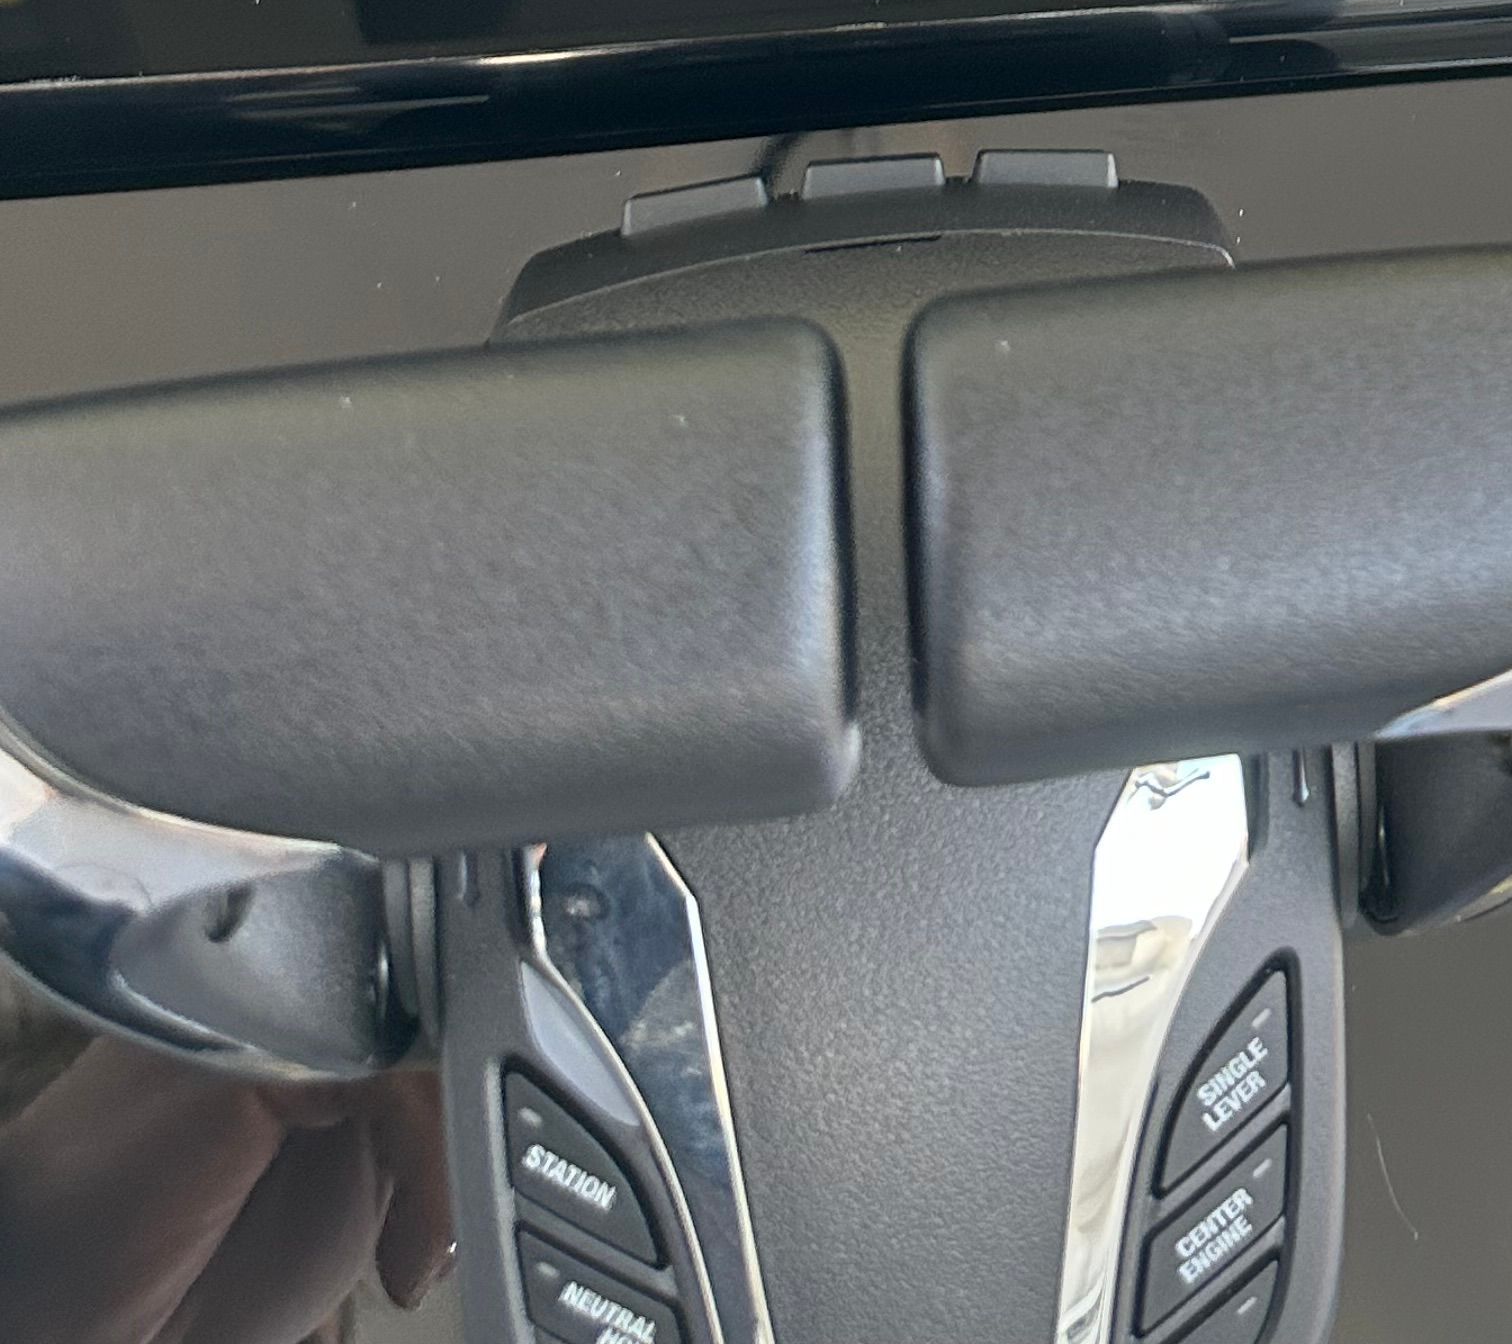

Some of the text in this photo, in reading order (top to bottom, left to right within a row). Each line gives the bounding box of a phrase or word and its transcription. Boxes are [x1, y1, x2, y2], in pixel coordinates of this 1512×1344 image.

[1197, 1036, 1269, 1107] SINGLE
[1202, 1070, 1266, 1132] LEVER
[521, 1144, 616, 1212] STATION
[1175, 1188, 1253, 1258] CENTER
[1177, 1215, 1253, 1284] ENGINE
